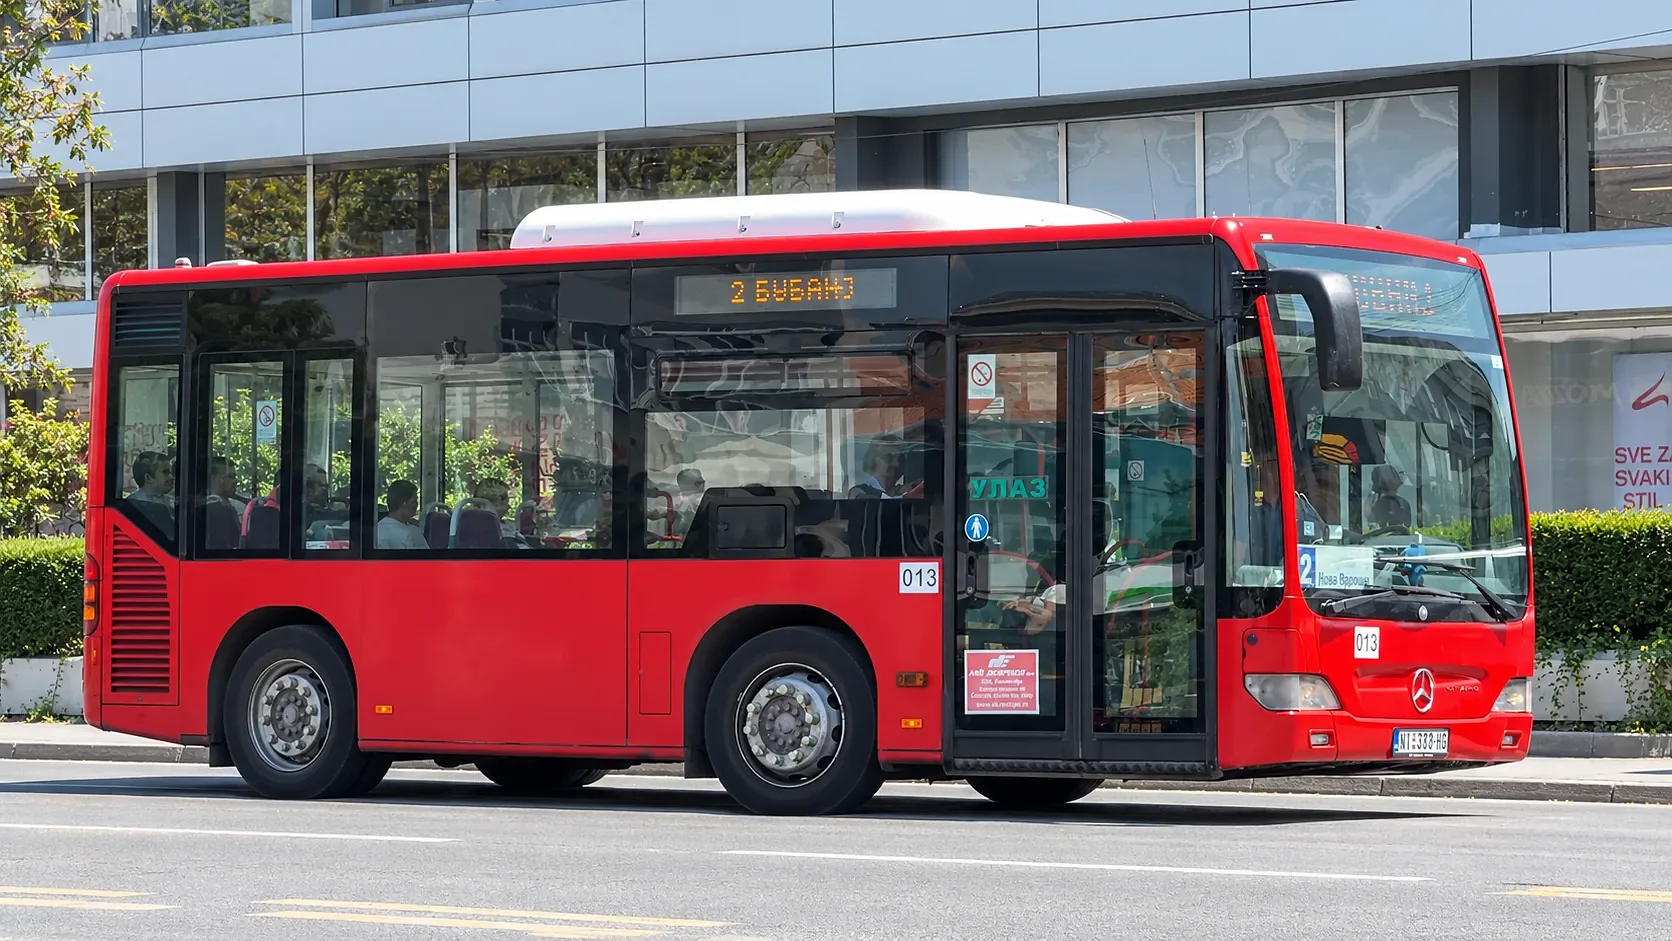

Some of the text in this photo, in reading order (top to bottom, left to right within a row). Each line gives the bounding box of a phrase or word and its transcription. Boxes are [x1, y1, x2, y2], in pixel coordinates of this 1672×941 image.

[731, 280, 745, 303] 2
[1614, 445, 1672, 464] SVE Z
[1615, 469, 1670, 487] SVAKI
[970, 477, 1047, 499] УЛАЗ
[1623, 492, 1664, 510] STIL
[902, 568, 937, 587] 013
[1300, 553, 1313, 585] 2
[1318, 571, 1338, 587] Нова
[1356, 633, 1378, 652] 013
